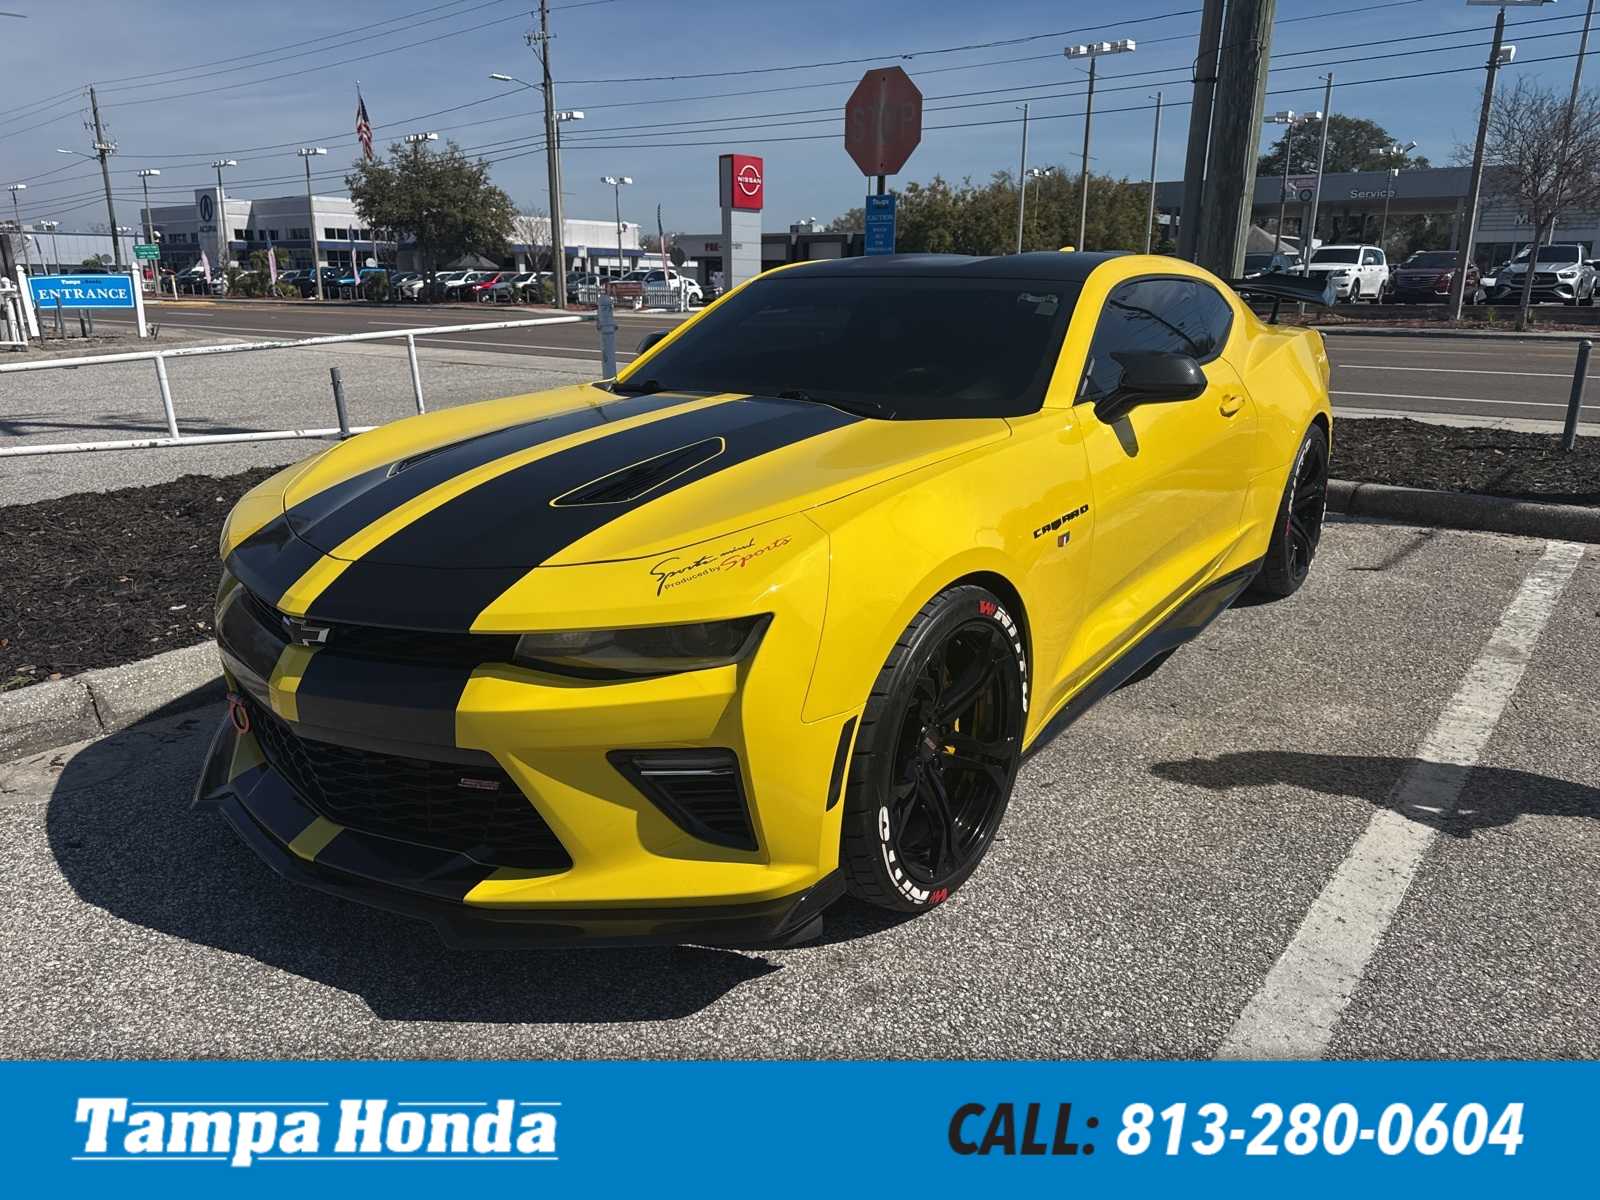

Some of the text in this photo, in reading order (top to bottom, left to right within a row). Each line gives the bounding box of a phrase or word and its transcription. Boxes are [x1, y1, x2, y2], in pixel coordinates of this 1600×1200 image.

[737, 175, 762, 185] NISSAN
[1350, 190, 1396, 199] Service
[39, 288, 128, 300] ENTRANCE
[1033, 503, 1089, 539] CAMARO
